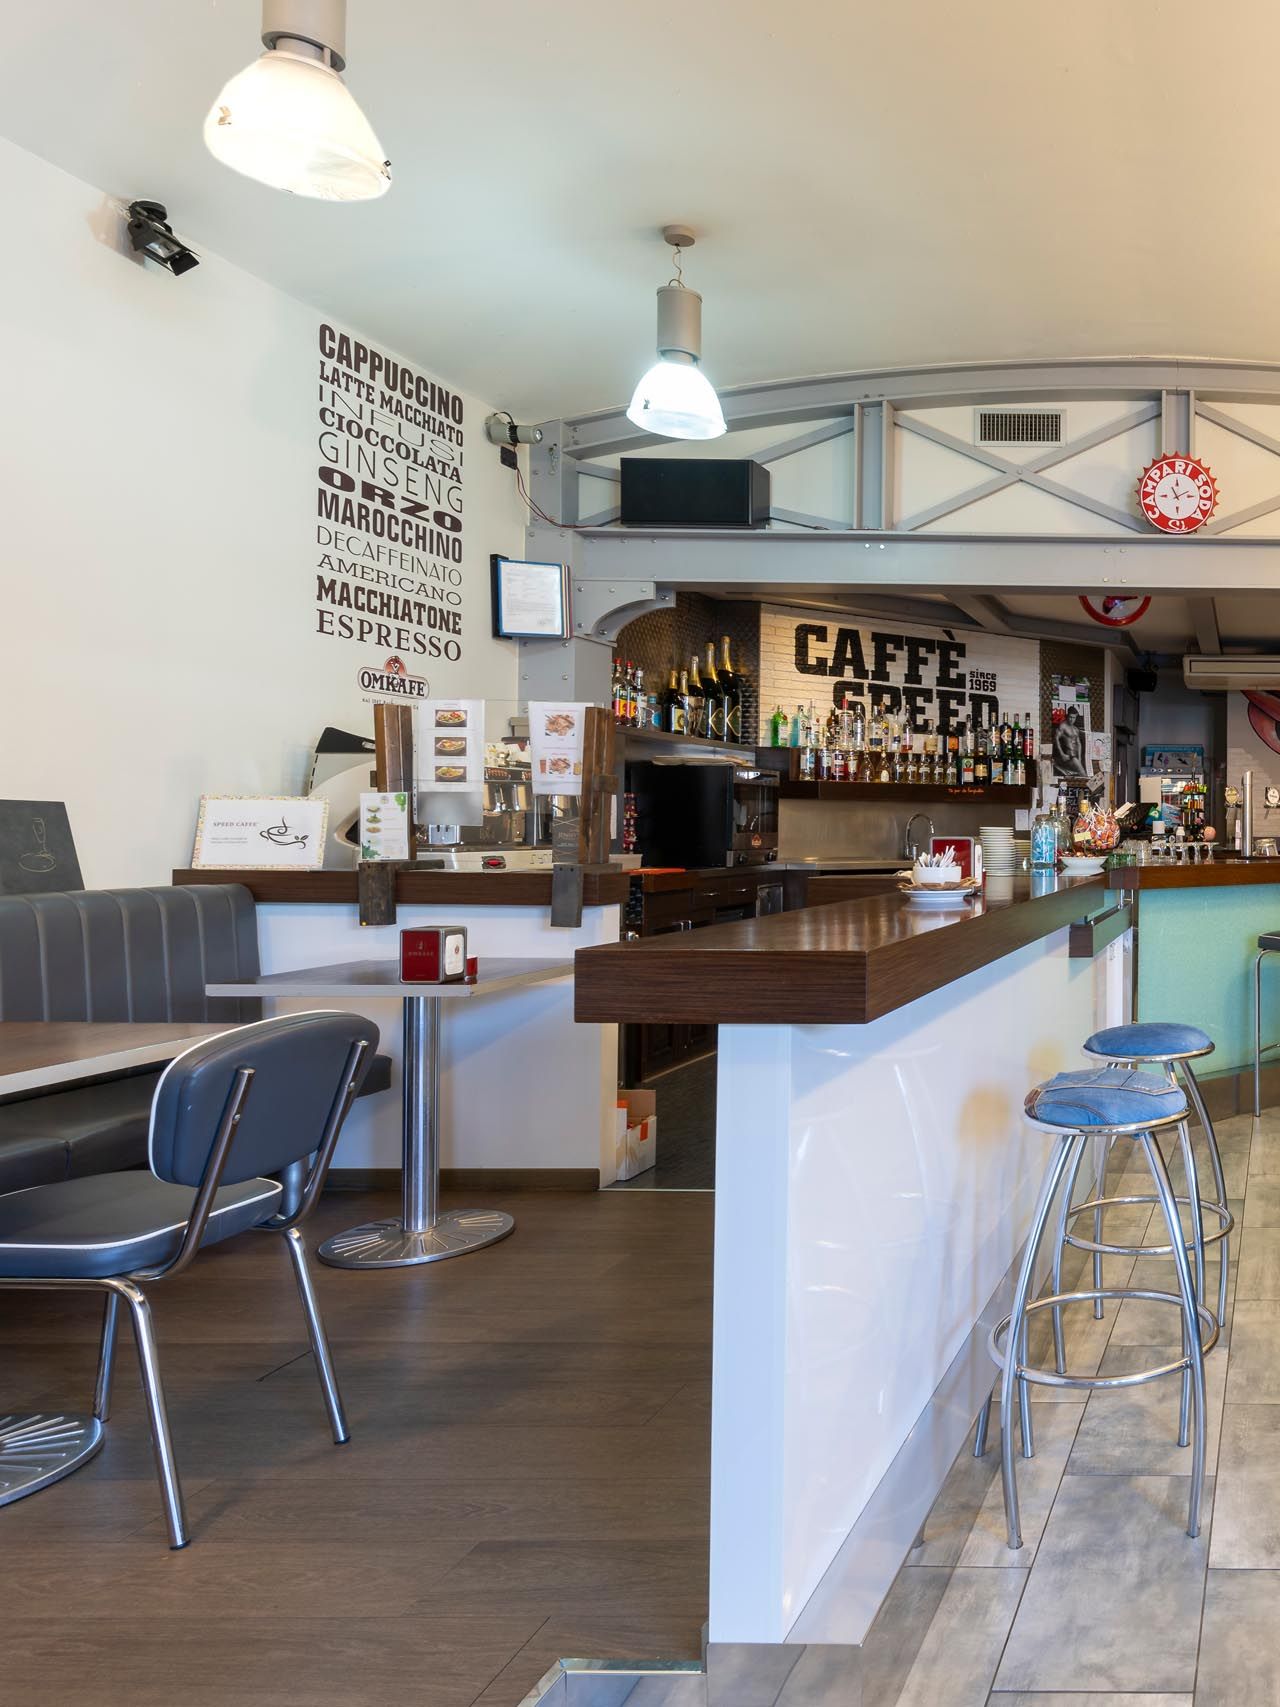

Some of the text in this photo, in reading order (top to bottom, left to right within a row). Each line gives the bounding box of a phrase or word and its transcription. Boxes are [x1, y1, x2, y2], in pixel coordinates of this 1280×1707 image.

[319, 323, 463, 425] CAPPUCCINO
[319, 360, 463, 447] LATTE MACCHIATO
[319, 384, 463, 466] INFUSI
[319, 407, 463, 484] CIOCCOLATA
[318, 465, 463, 533] ORZO
[319, 431, 463, 513] GINSENG
[1143, 461, 1212, 521] CAMPARI SODA
[317, 488, 462, 563] MAROCCHINO
[317, 525, 462, 587] DECAFFEINATO
[316, 575, 462, 635] MACCHIATONE
[317, 553, 462, 606] AMERICANO
[316, 608, 462, 662] ESPRESSO
[794, 622, 966, 689] CAFFÈ
[968, 679, 997, 692] 1969
